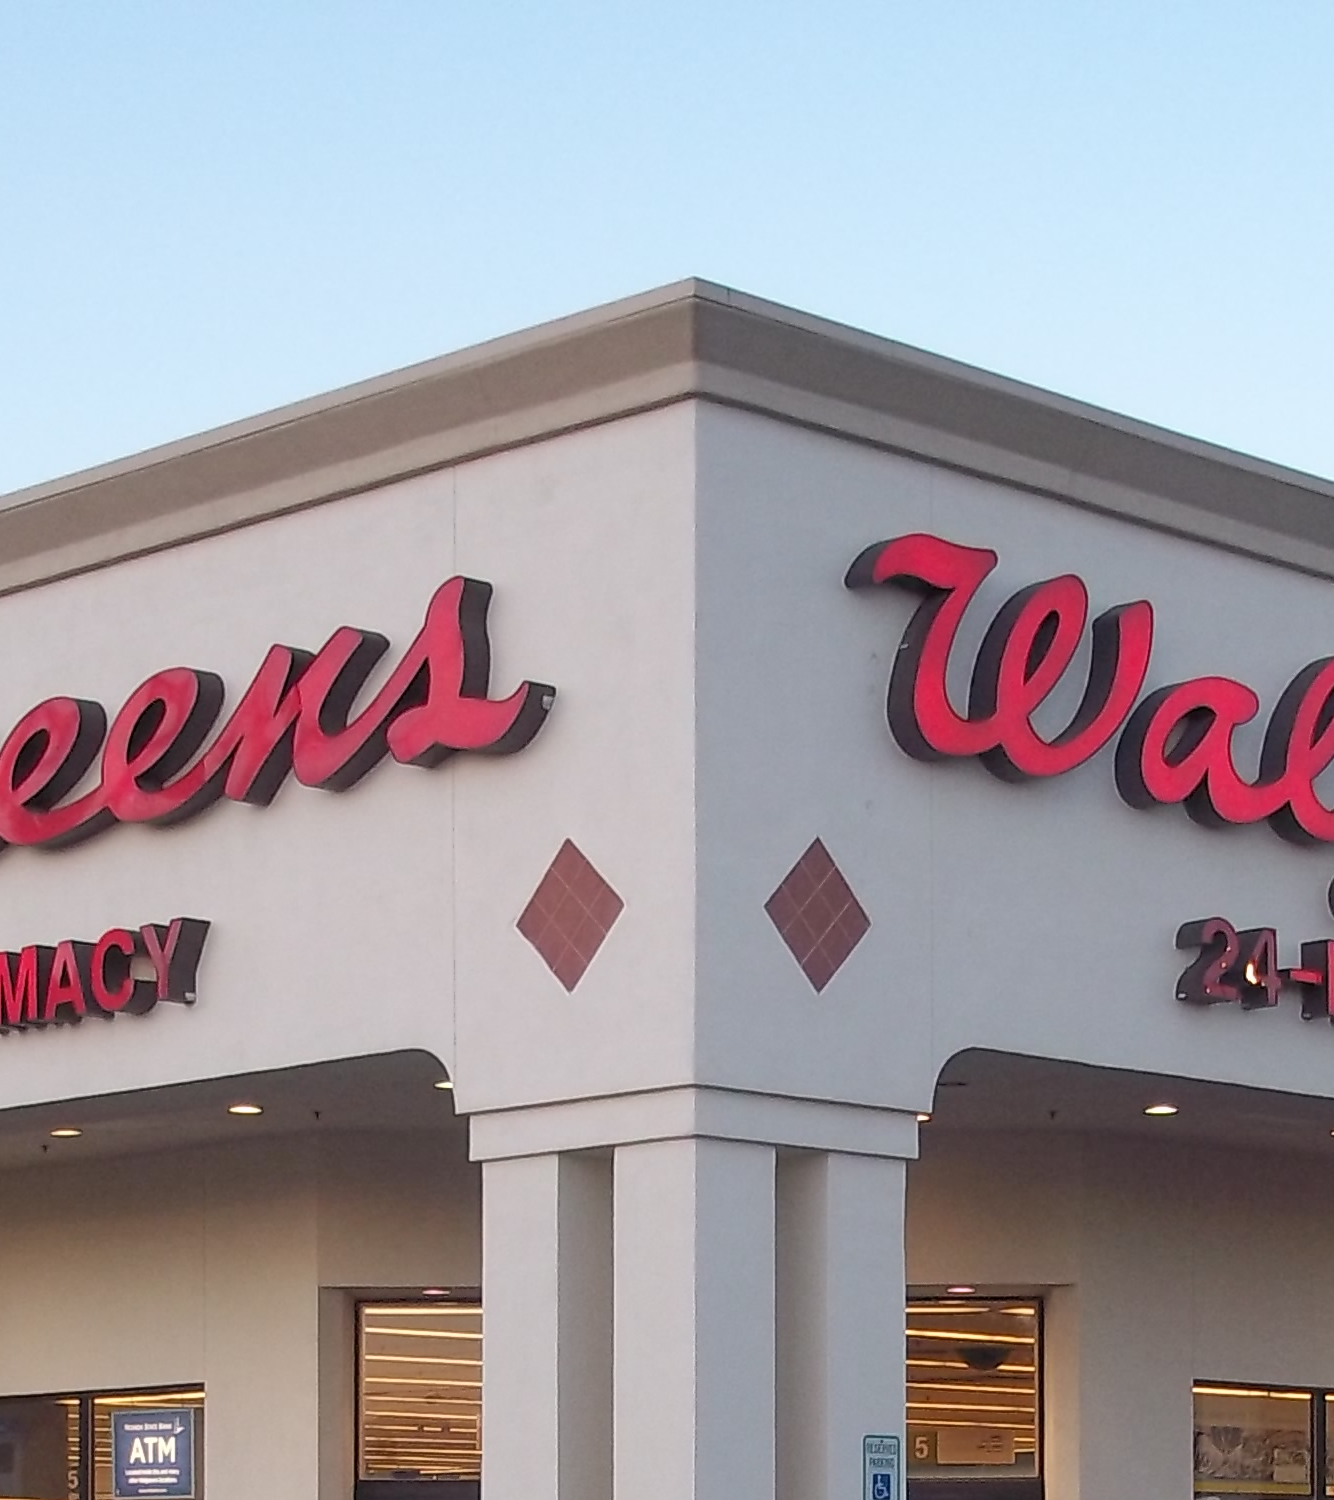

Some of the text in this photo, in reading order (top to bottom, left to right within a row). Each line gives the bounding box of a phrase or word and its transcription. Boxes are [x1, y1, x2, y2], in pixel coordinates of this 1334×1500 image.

[129, 1436, 176, 1465] ATM
[914, 1436, 929, 1459] 5
[67, 1470, 79, 1490] 5
